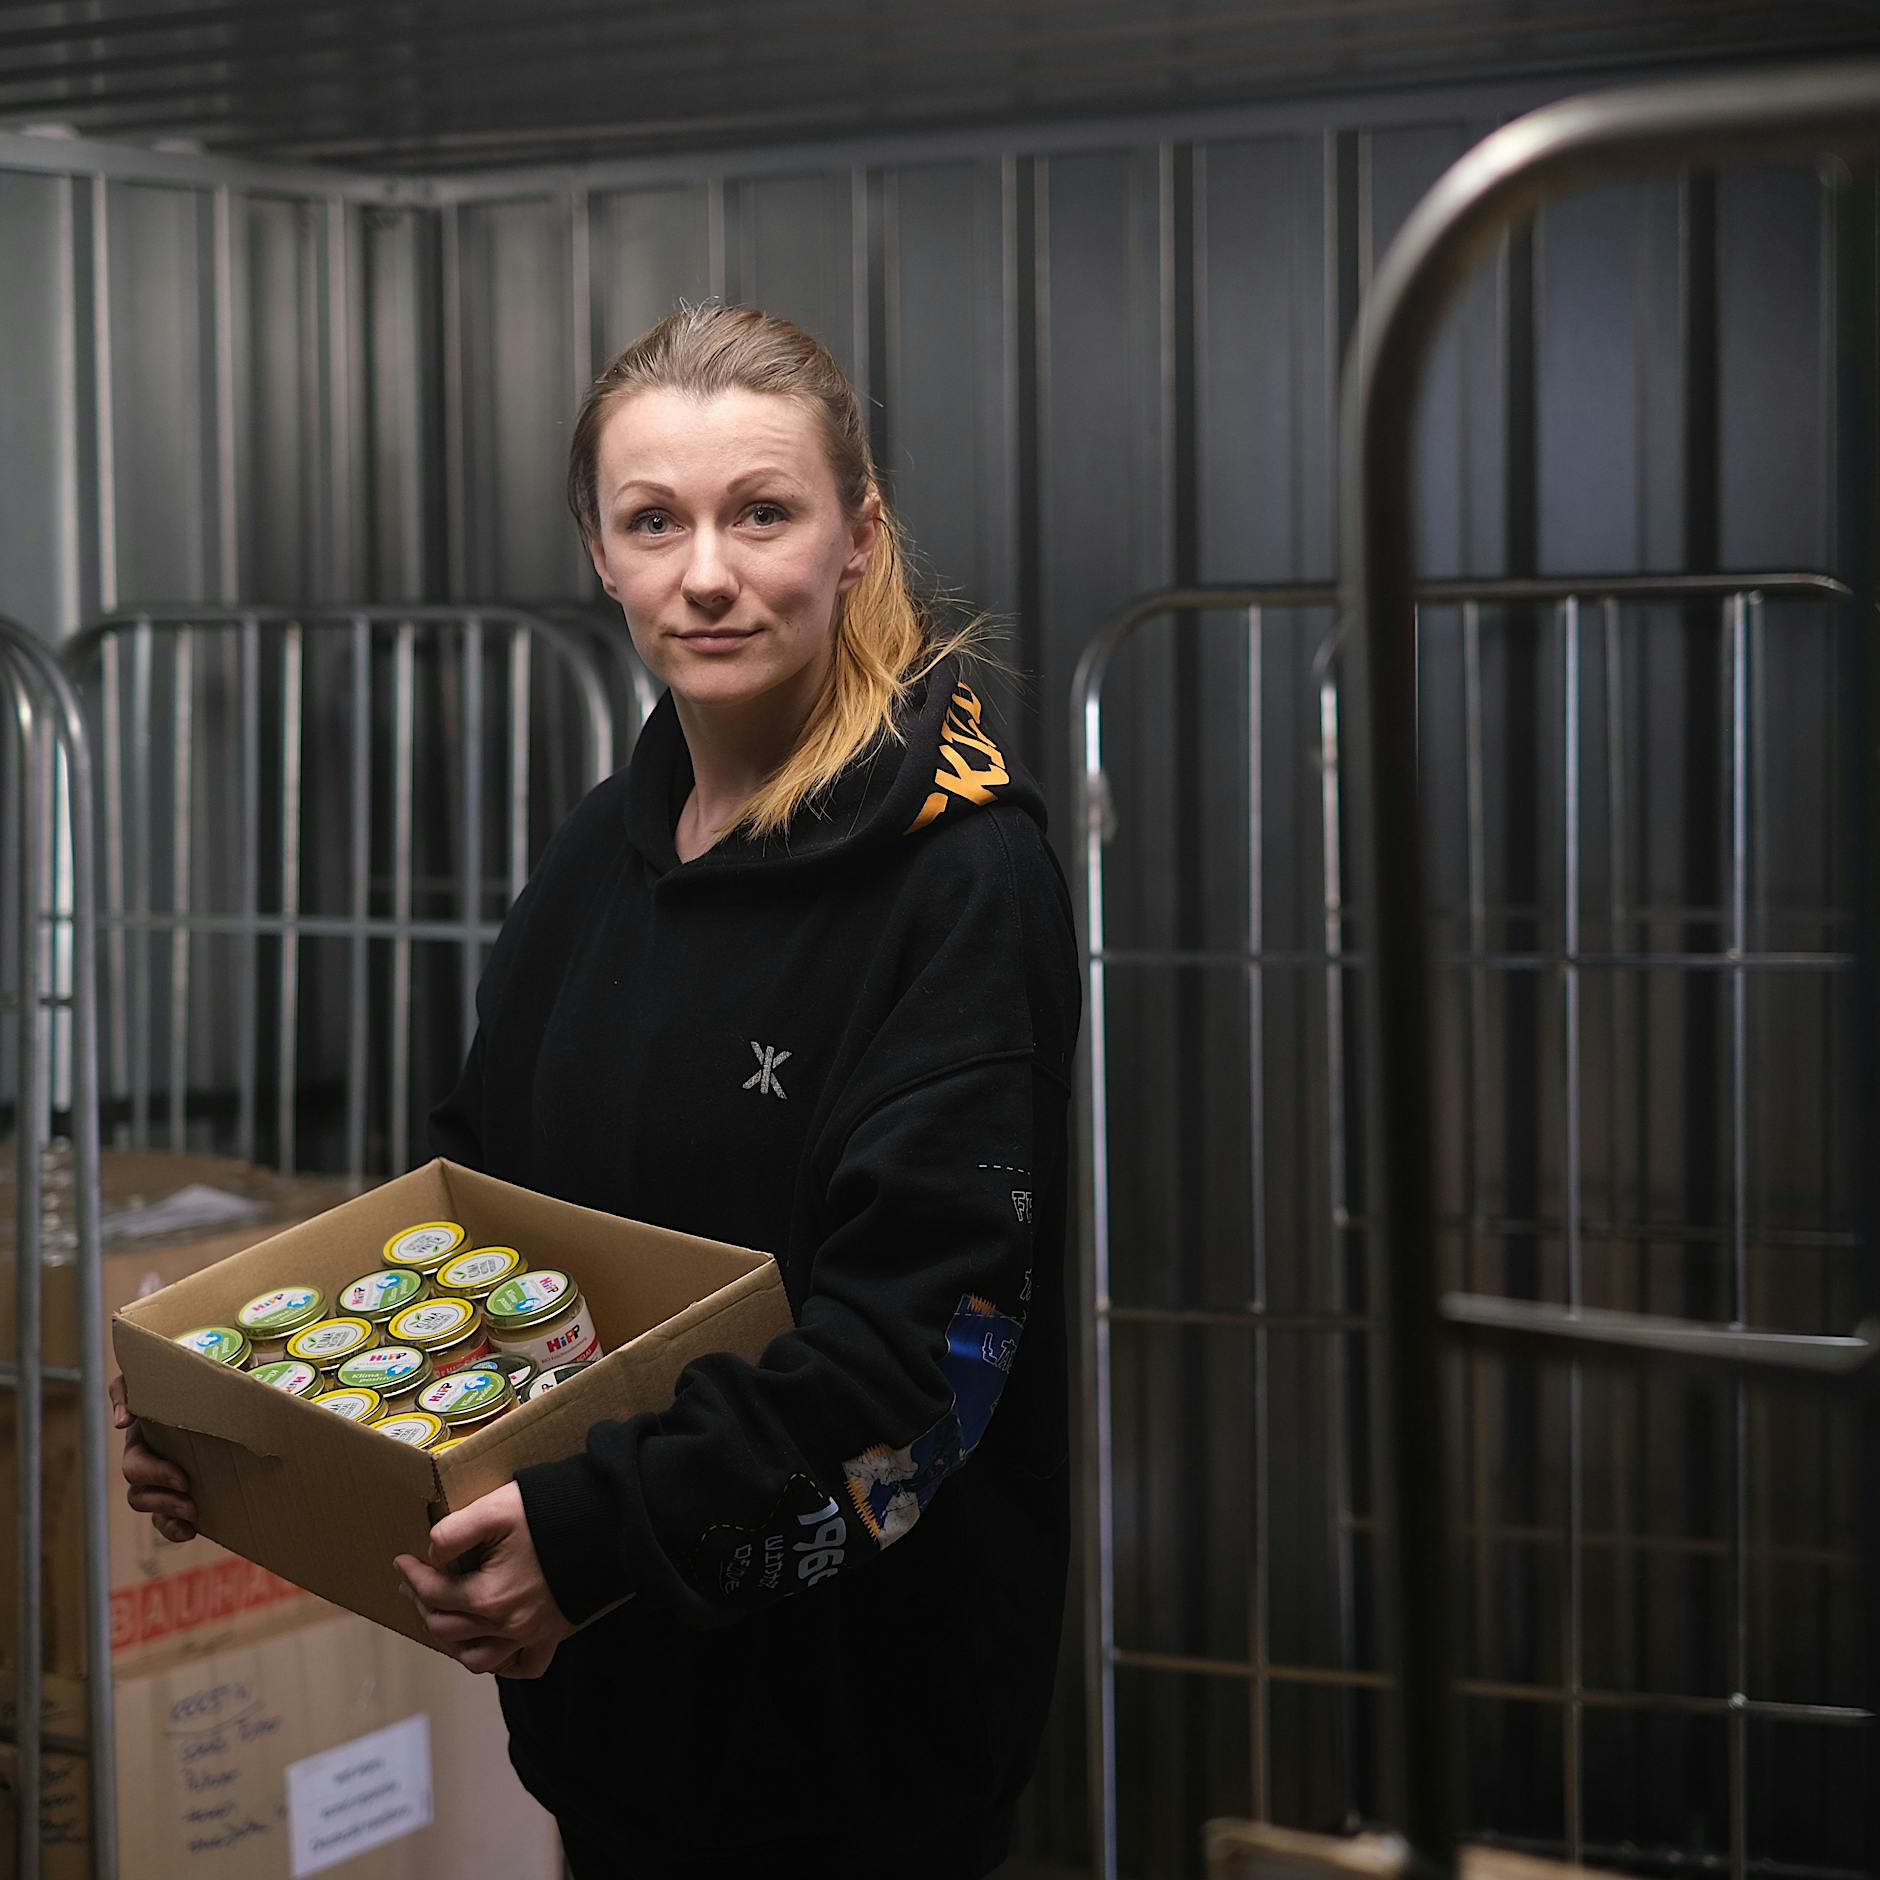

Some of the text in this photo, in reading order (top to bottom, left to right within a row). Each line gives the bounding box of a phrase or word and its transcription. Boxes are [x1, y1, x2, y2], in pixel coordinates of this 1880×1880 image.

[546, 1324, 581, 1353] HiPP
[369, 1351, 408, 1362] HiPP
[428, 1382, 454, 1402] HiPP
